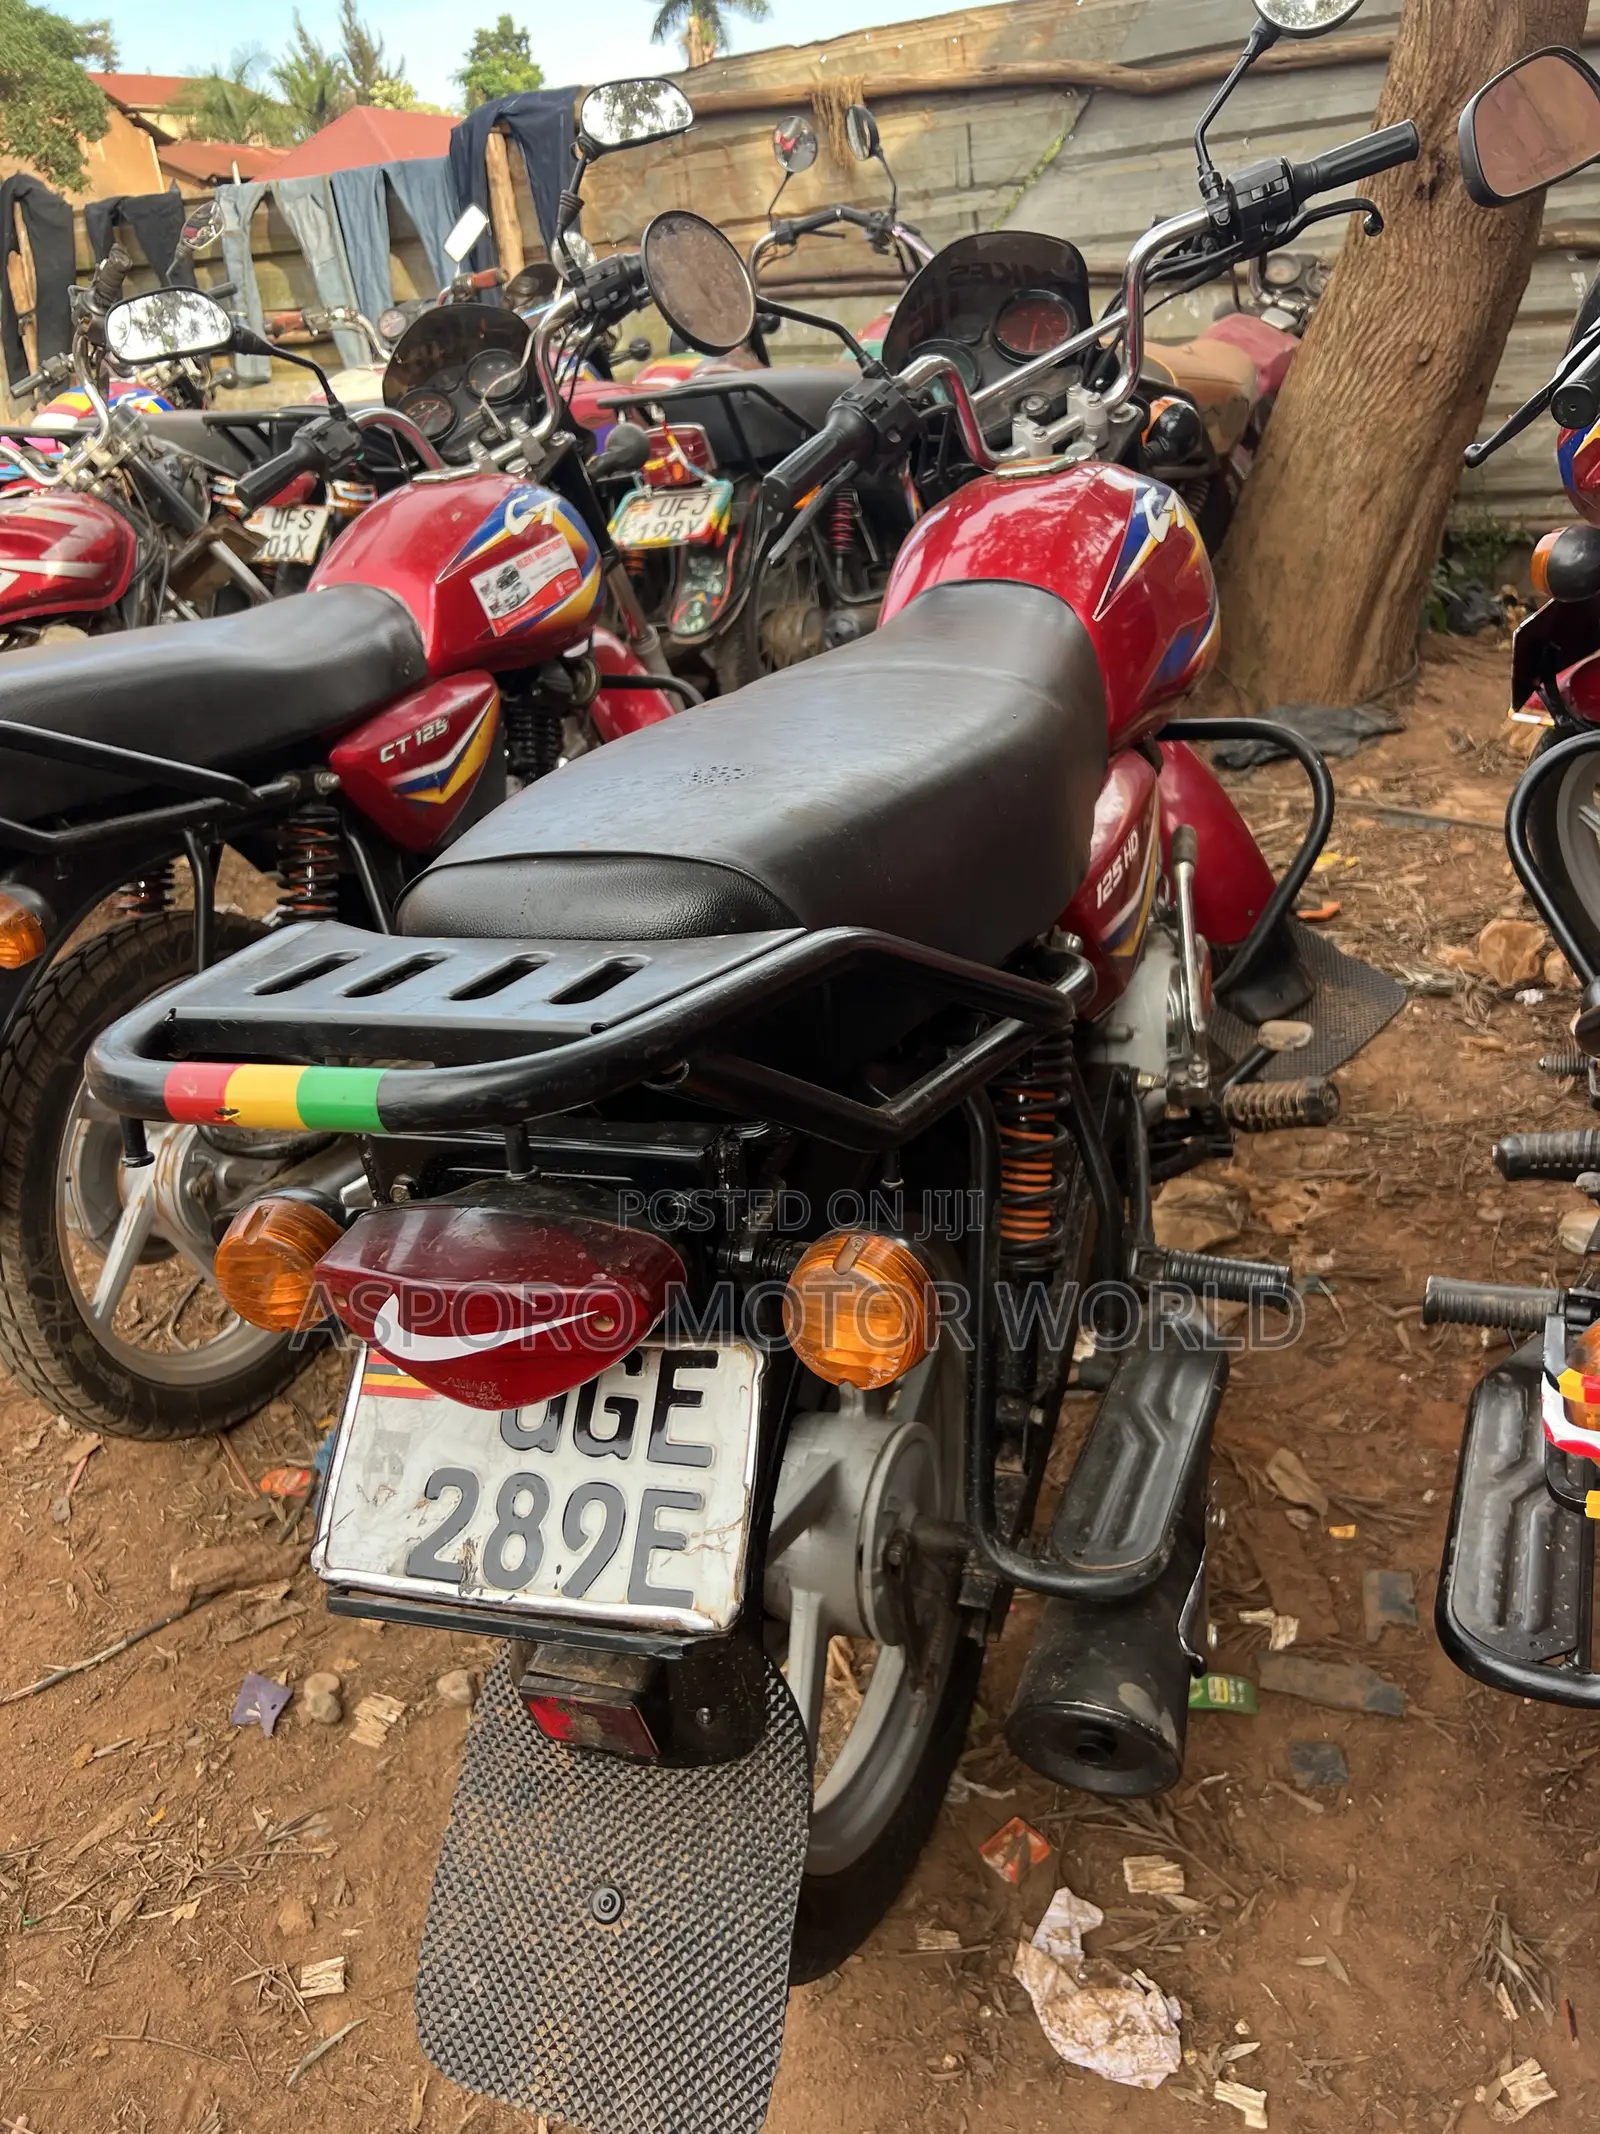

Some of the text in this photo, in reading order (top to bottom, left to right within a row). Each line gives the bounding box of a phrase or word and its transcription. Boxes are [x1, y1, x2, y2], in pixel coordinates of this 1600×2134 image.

[271, 507, 316, 530] UFS
[658, 493, 712, 517] UFJ
[260, 535, 309, 558] 01X
[380, 718, 449, 763] CT 125
[1097, 829, 1139, 909] 125 HD
[405, 1466, 705, 1610] 289E
